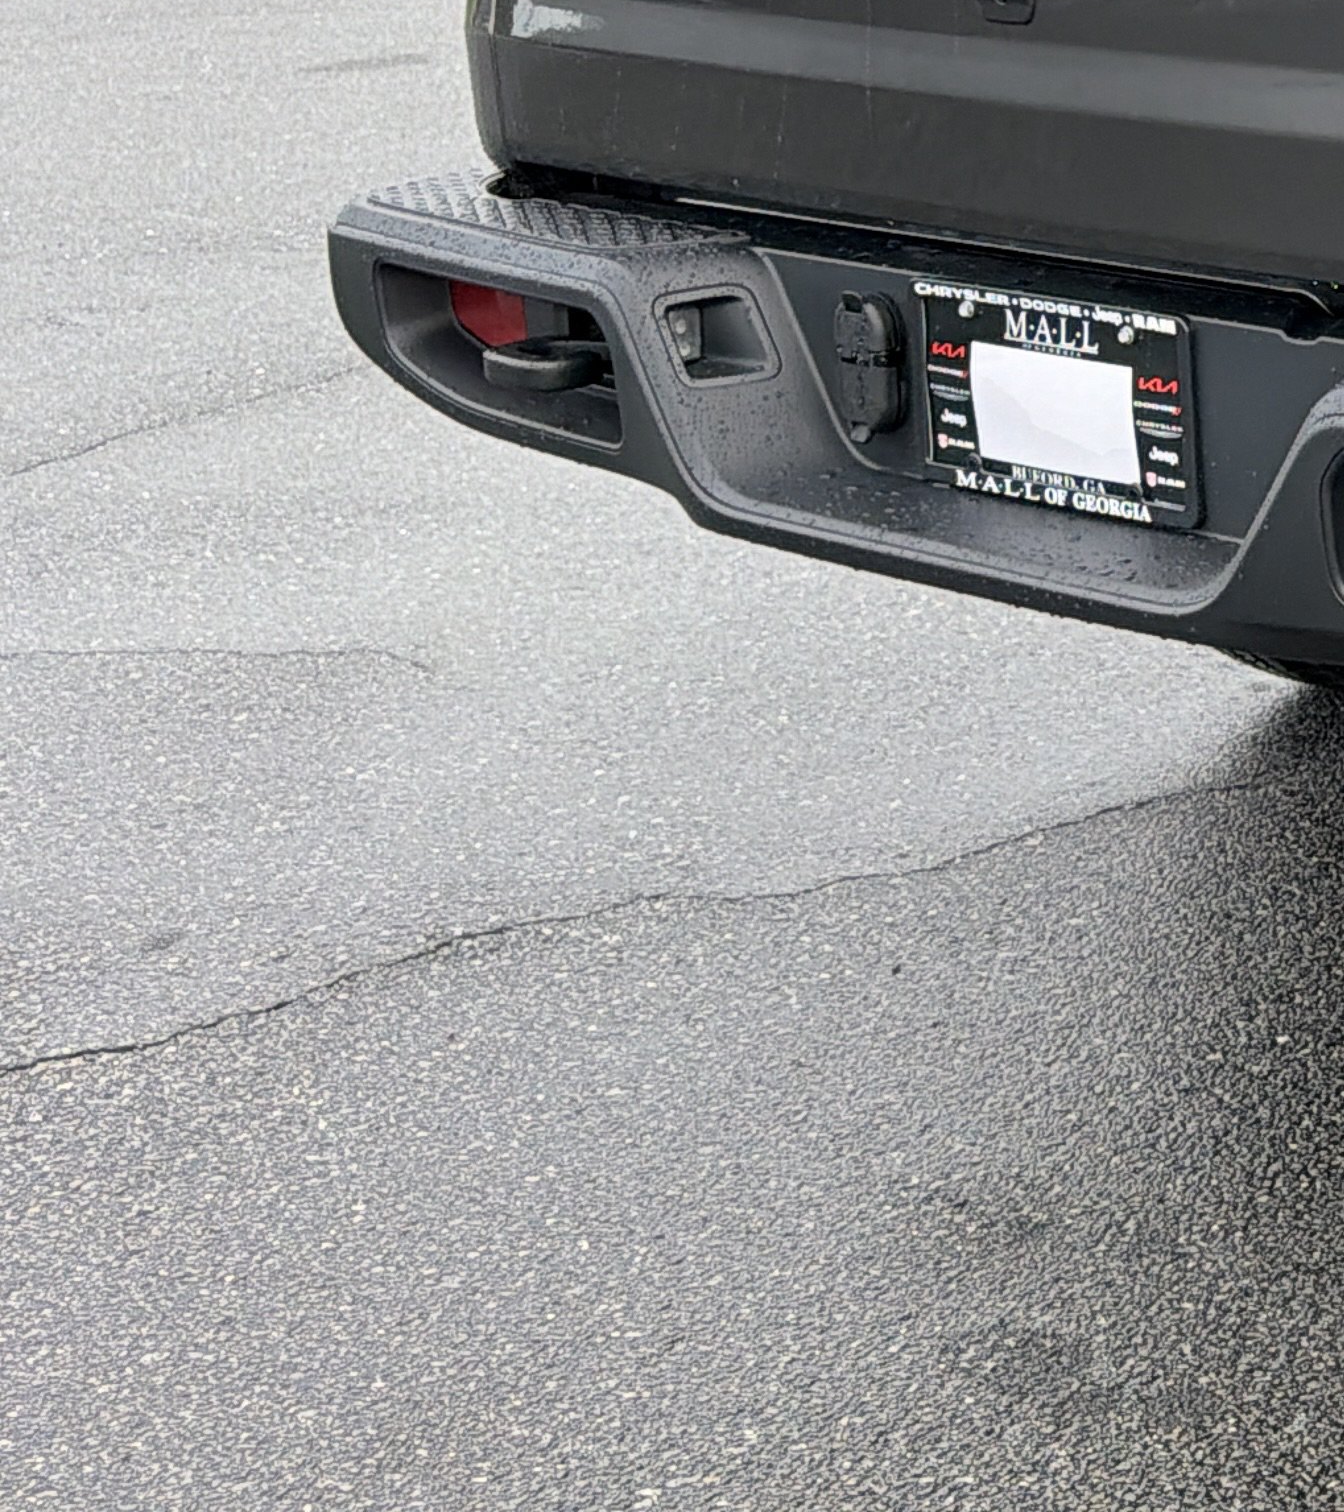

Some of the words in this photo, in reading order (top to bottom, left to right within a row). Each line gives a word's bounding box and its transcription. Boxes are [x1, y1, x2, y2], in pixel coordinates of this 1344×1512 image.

[914, 282, 1010, 306] CHRYSLER
[1020, 298, 1082, 317] DODGE
[1092, 306, 1123, 326] Jeep
[1132, 314, 1177, 335] RAM
[1044, 487, 1069, 506] OF
[1072, 491, 1153, 524] GEORGIA
